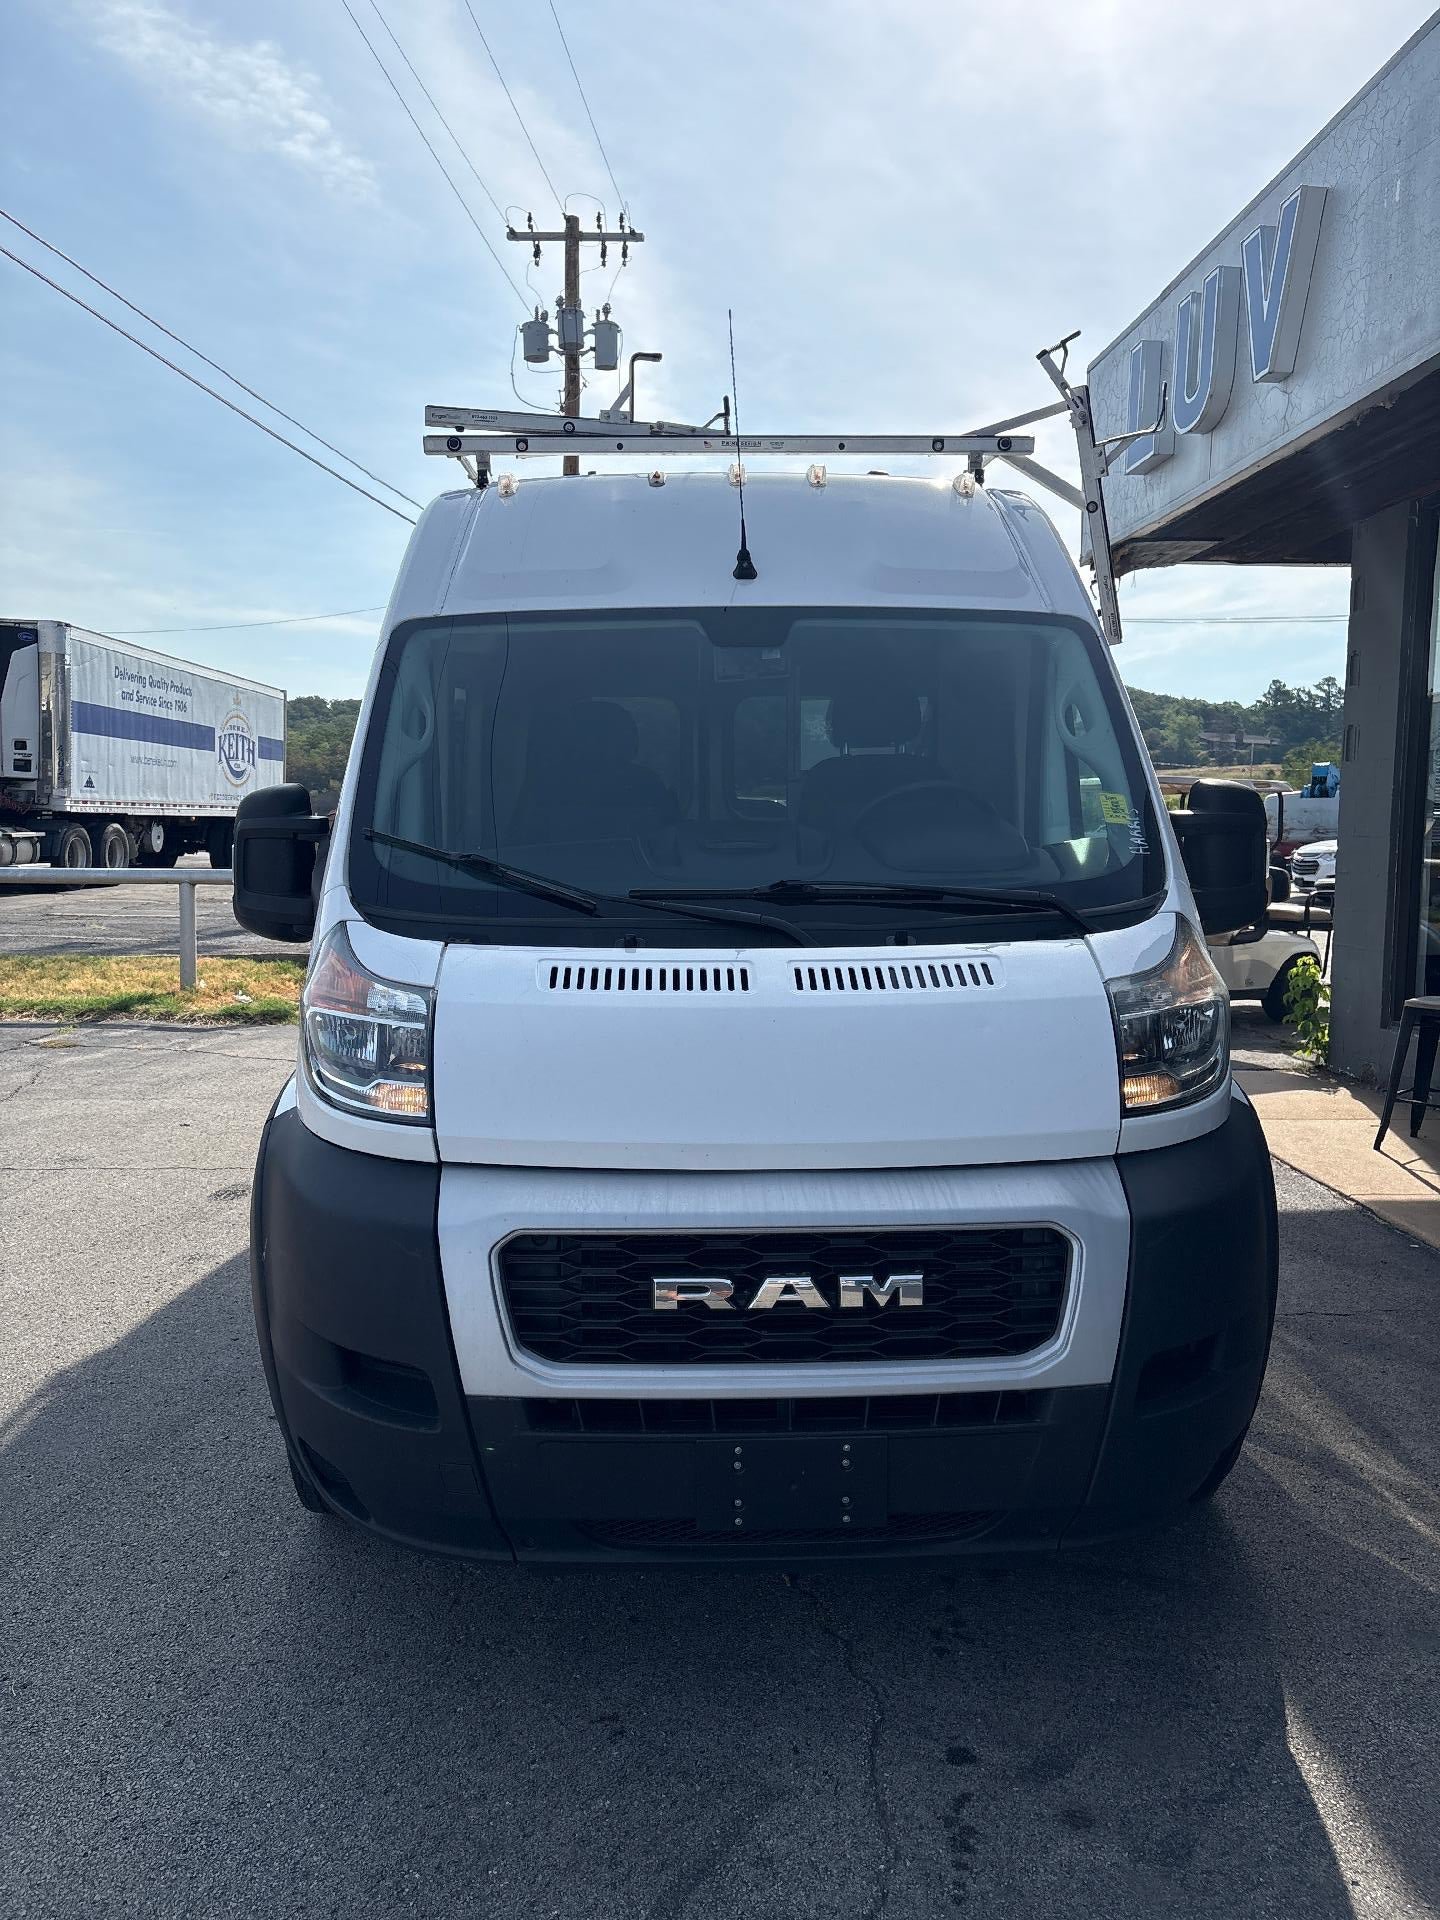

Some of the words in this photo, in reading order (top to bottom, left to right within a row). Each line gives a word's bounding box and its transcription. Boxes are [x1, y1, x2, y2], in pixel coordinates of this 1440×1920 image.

[114, 666, 147, 688] Delivering
[148, 675, 169, 694] Quality
[170, 680, 192, 697] Products
[121, 690, 134, 702] and
[136, 690, 157, 707] Service
[159, 695, 173, 711] Since
[174, 699, 187, 713] 1906
[217, 733, 256, 770] KEITH
[653, 1274, 924, 1310] RAM
